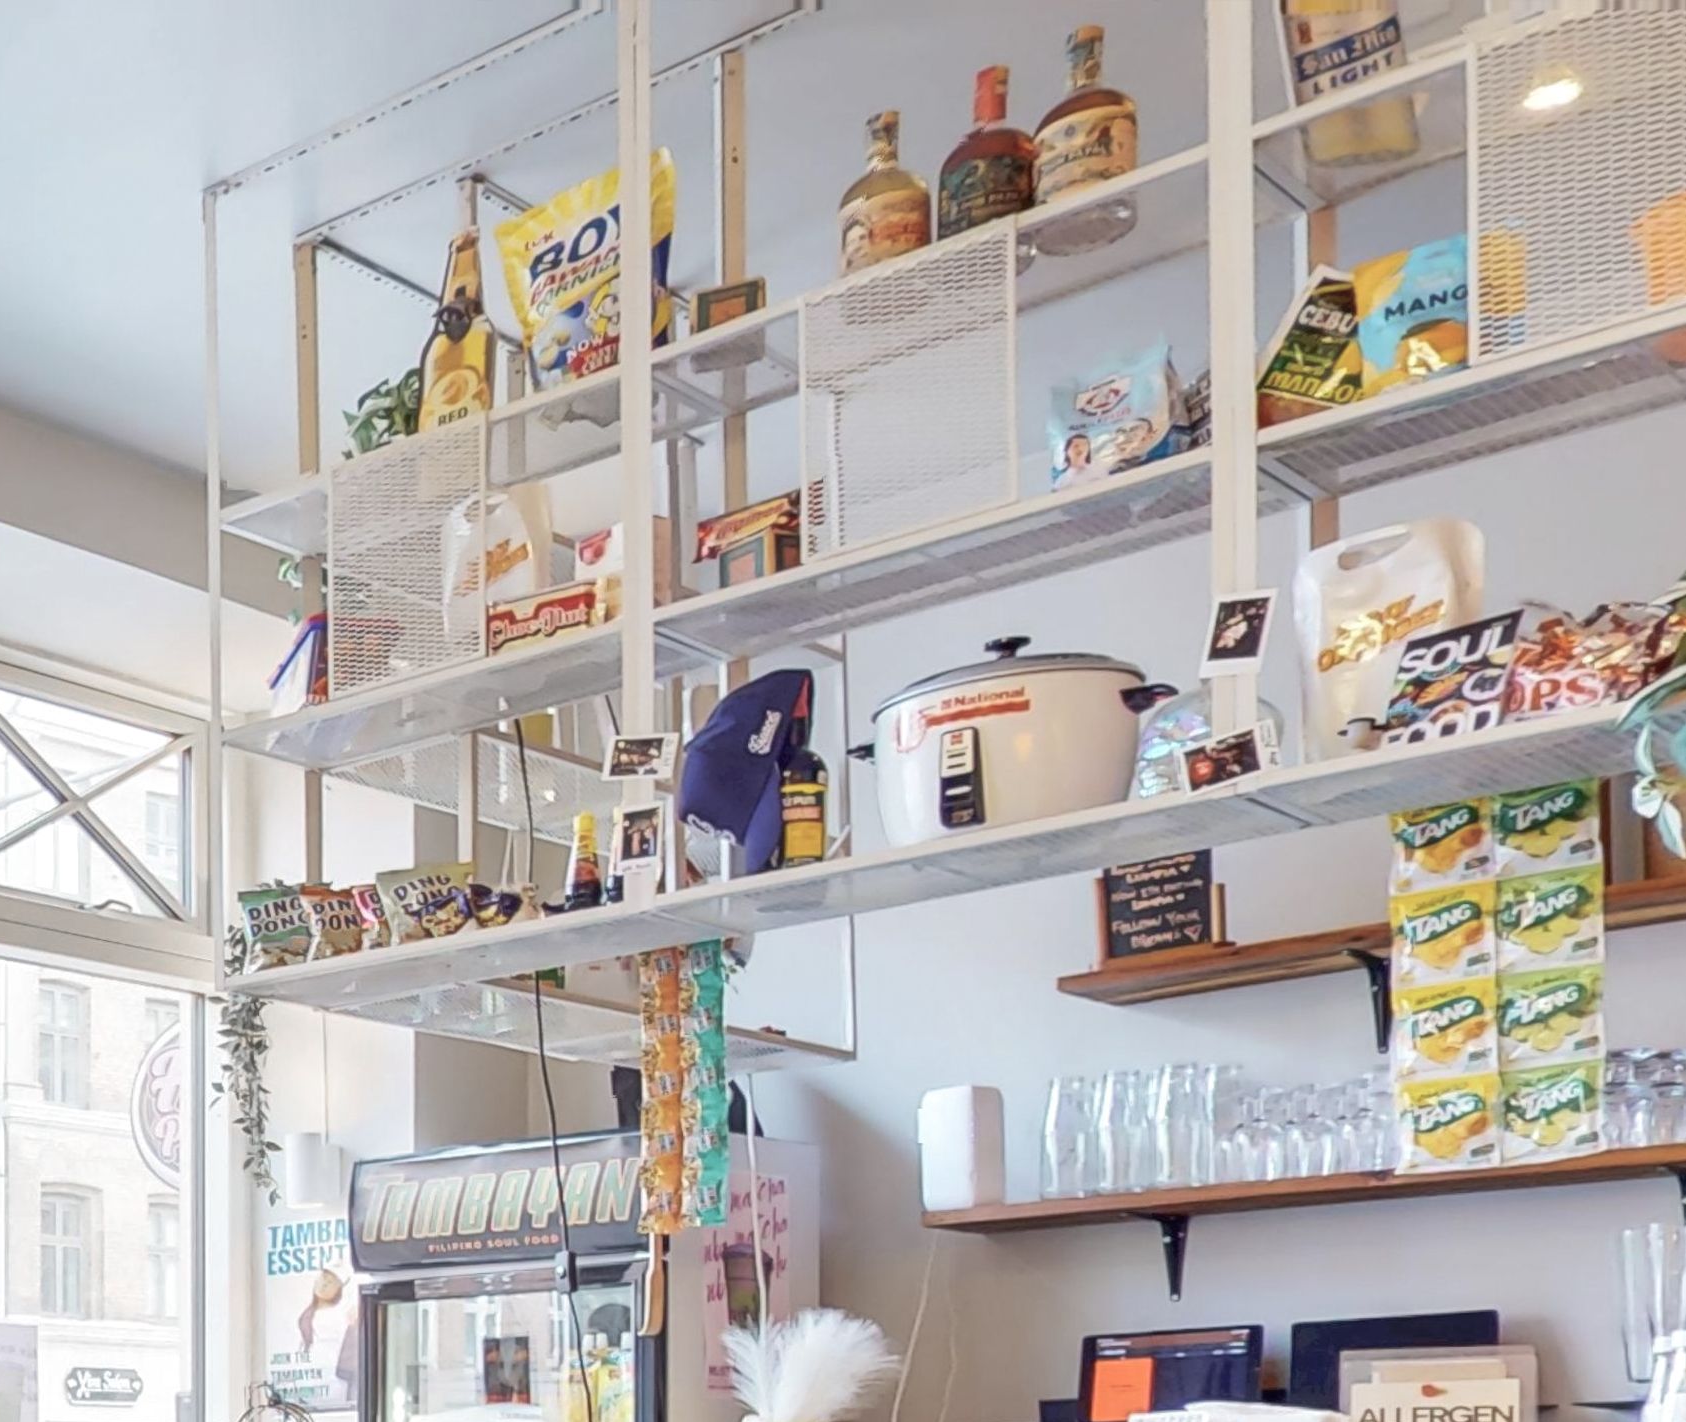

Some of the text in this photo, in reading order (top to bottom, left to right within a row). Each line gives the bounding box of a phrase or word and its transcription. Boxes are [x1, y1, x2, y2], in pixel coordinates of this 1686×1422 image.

[1313, 51, 1395, 95] LIGHT
[1297, 304, 1360, 335] CEBU
[1397, 618, 1513, 678] SOUL
[954, 686, 1026, 707] National
[1413, 808, 1471, 847] TANG
[1509, 790, 1574, 830] TANG
[392, 874, 452, 902] DING
[1515, 888, 1579, 927] TANG
[1112, 914, 1163, 936] FOLLOW
[1412, 902, 1474, 942] TANG
[1416, 997, 1477, 1036] TANG
[1414, 1097, 1477, 1133] TANG
[360, 1157, 643, 1244] TAMBAYAN
[428, 1240, 483, 1254] FILIPINO
[486, 1238, 520, 1250] SOUL
